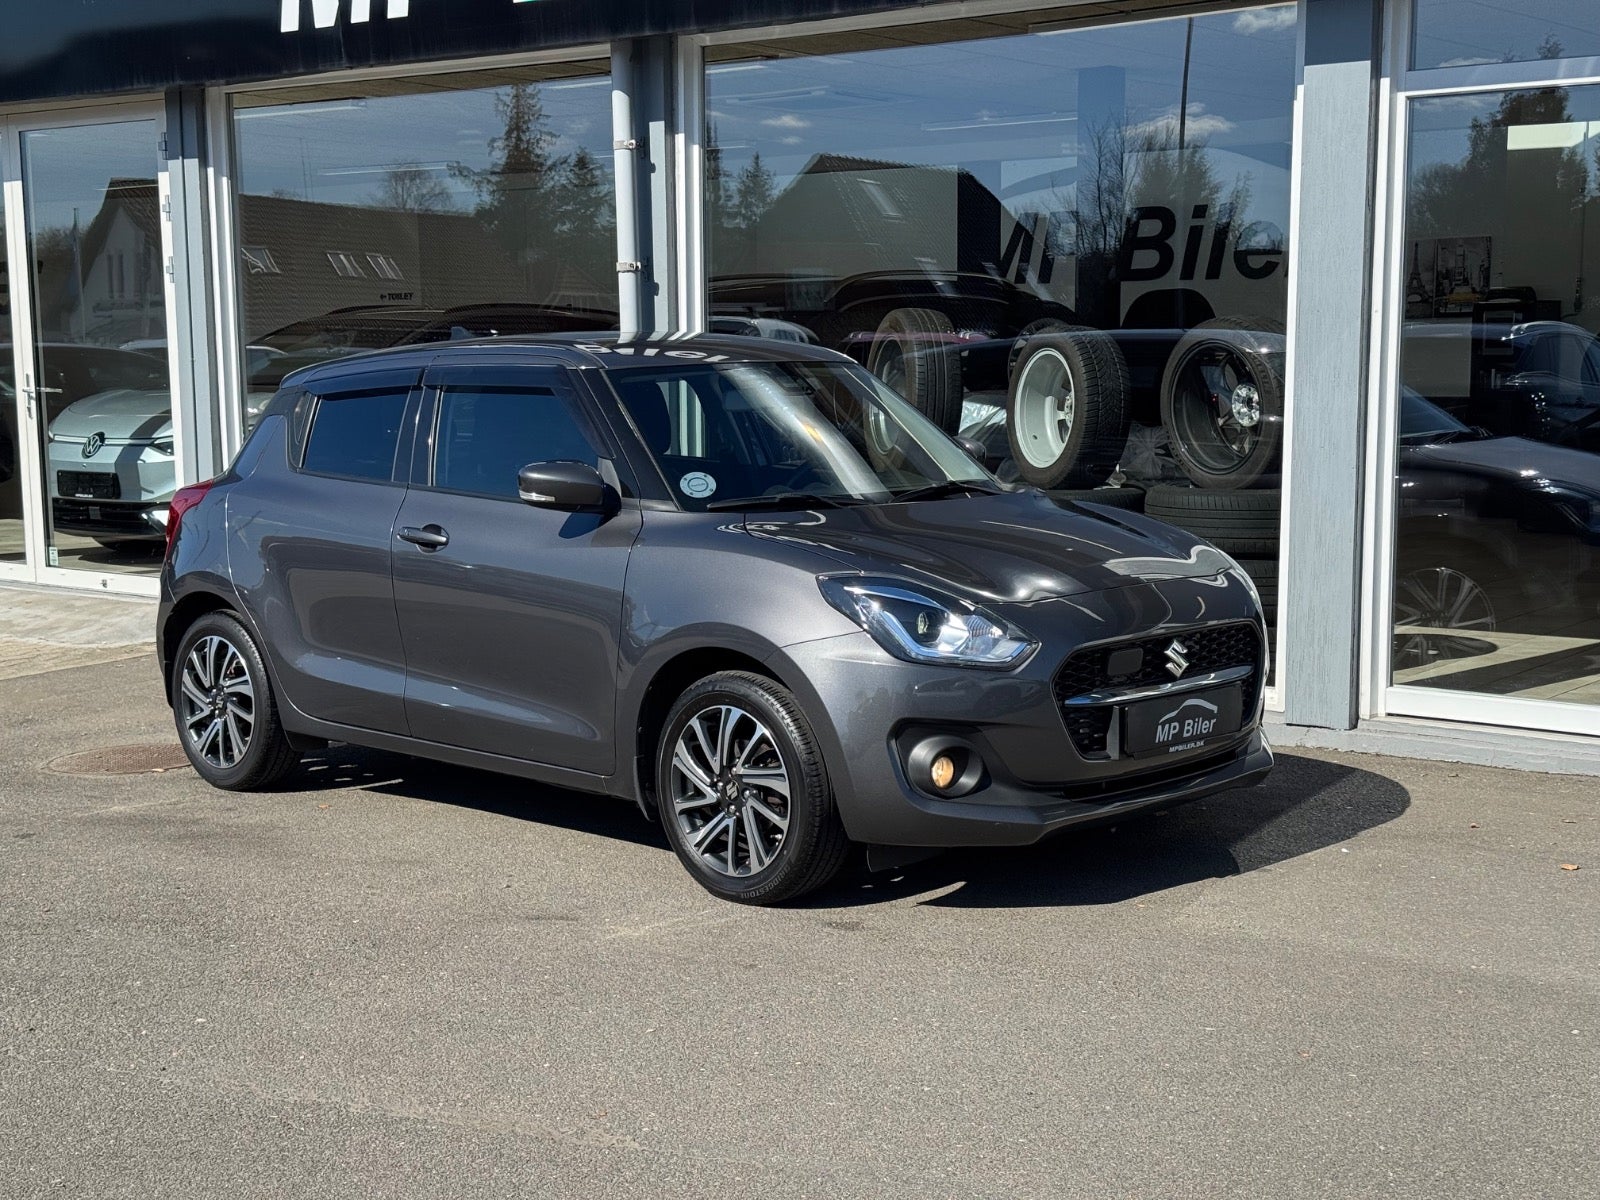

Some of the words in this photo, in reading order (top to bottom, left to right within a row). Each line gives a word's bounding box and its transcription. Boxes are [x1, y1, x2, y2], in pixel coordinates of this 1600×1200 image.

[1120, 203, 1288, 281] Bile
[387, 292, 414, 301] TOILET
[1155, 721, 1180, 743] MP
[1182, 717, 1217, 738] Biler
